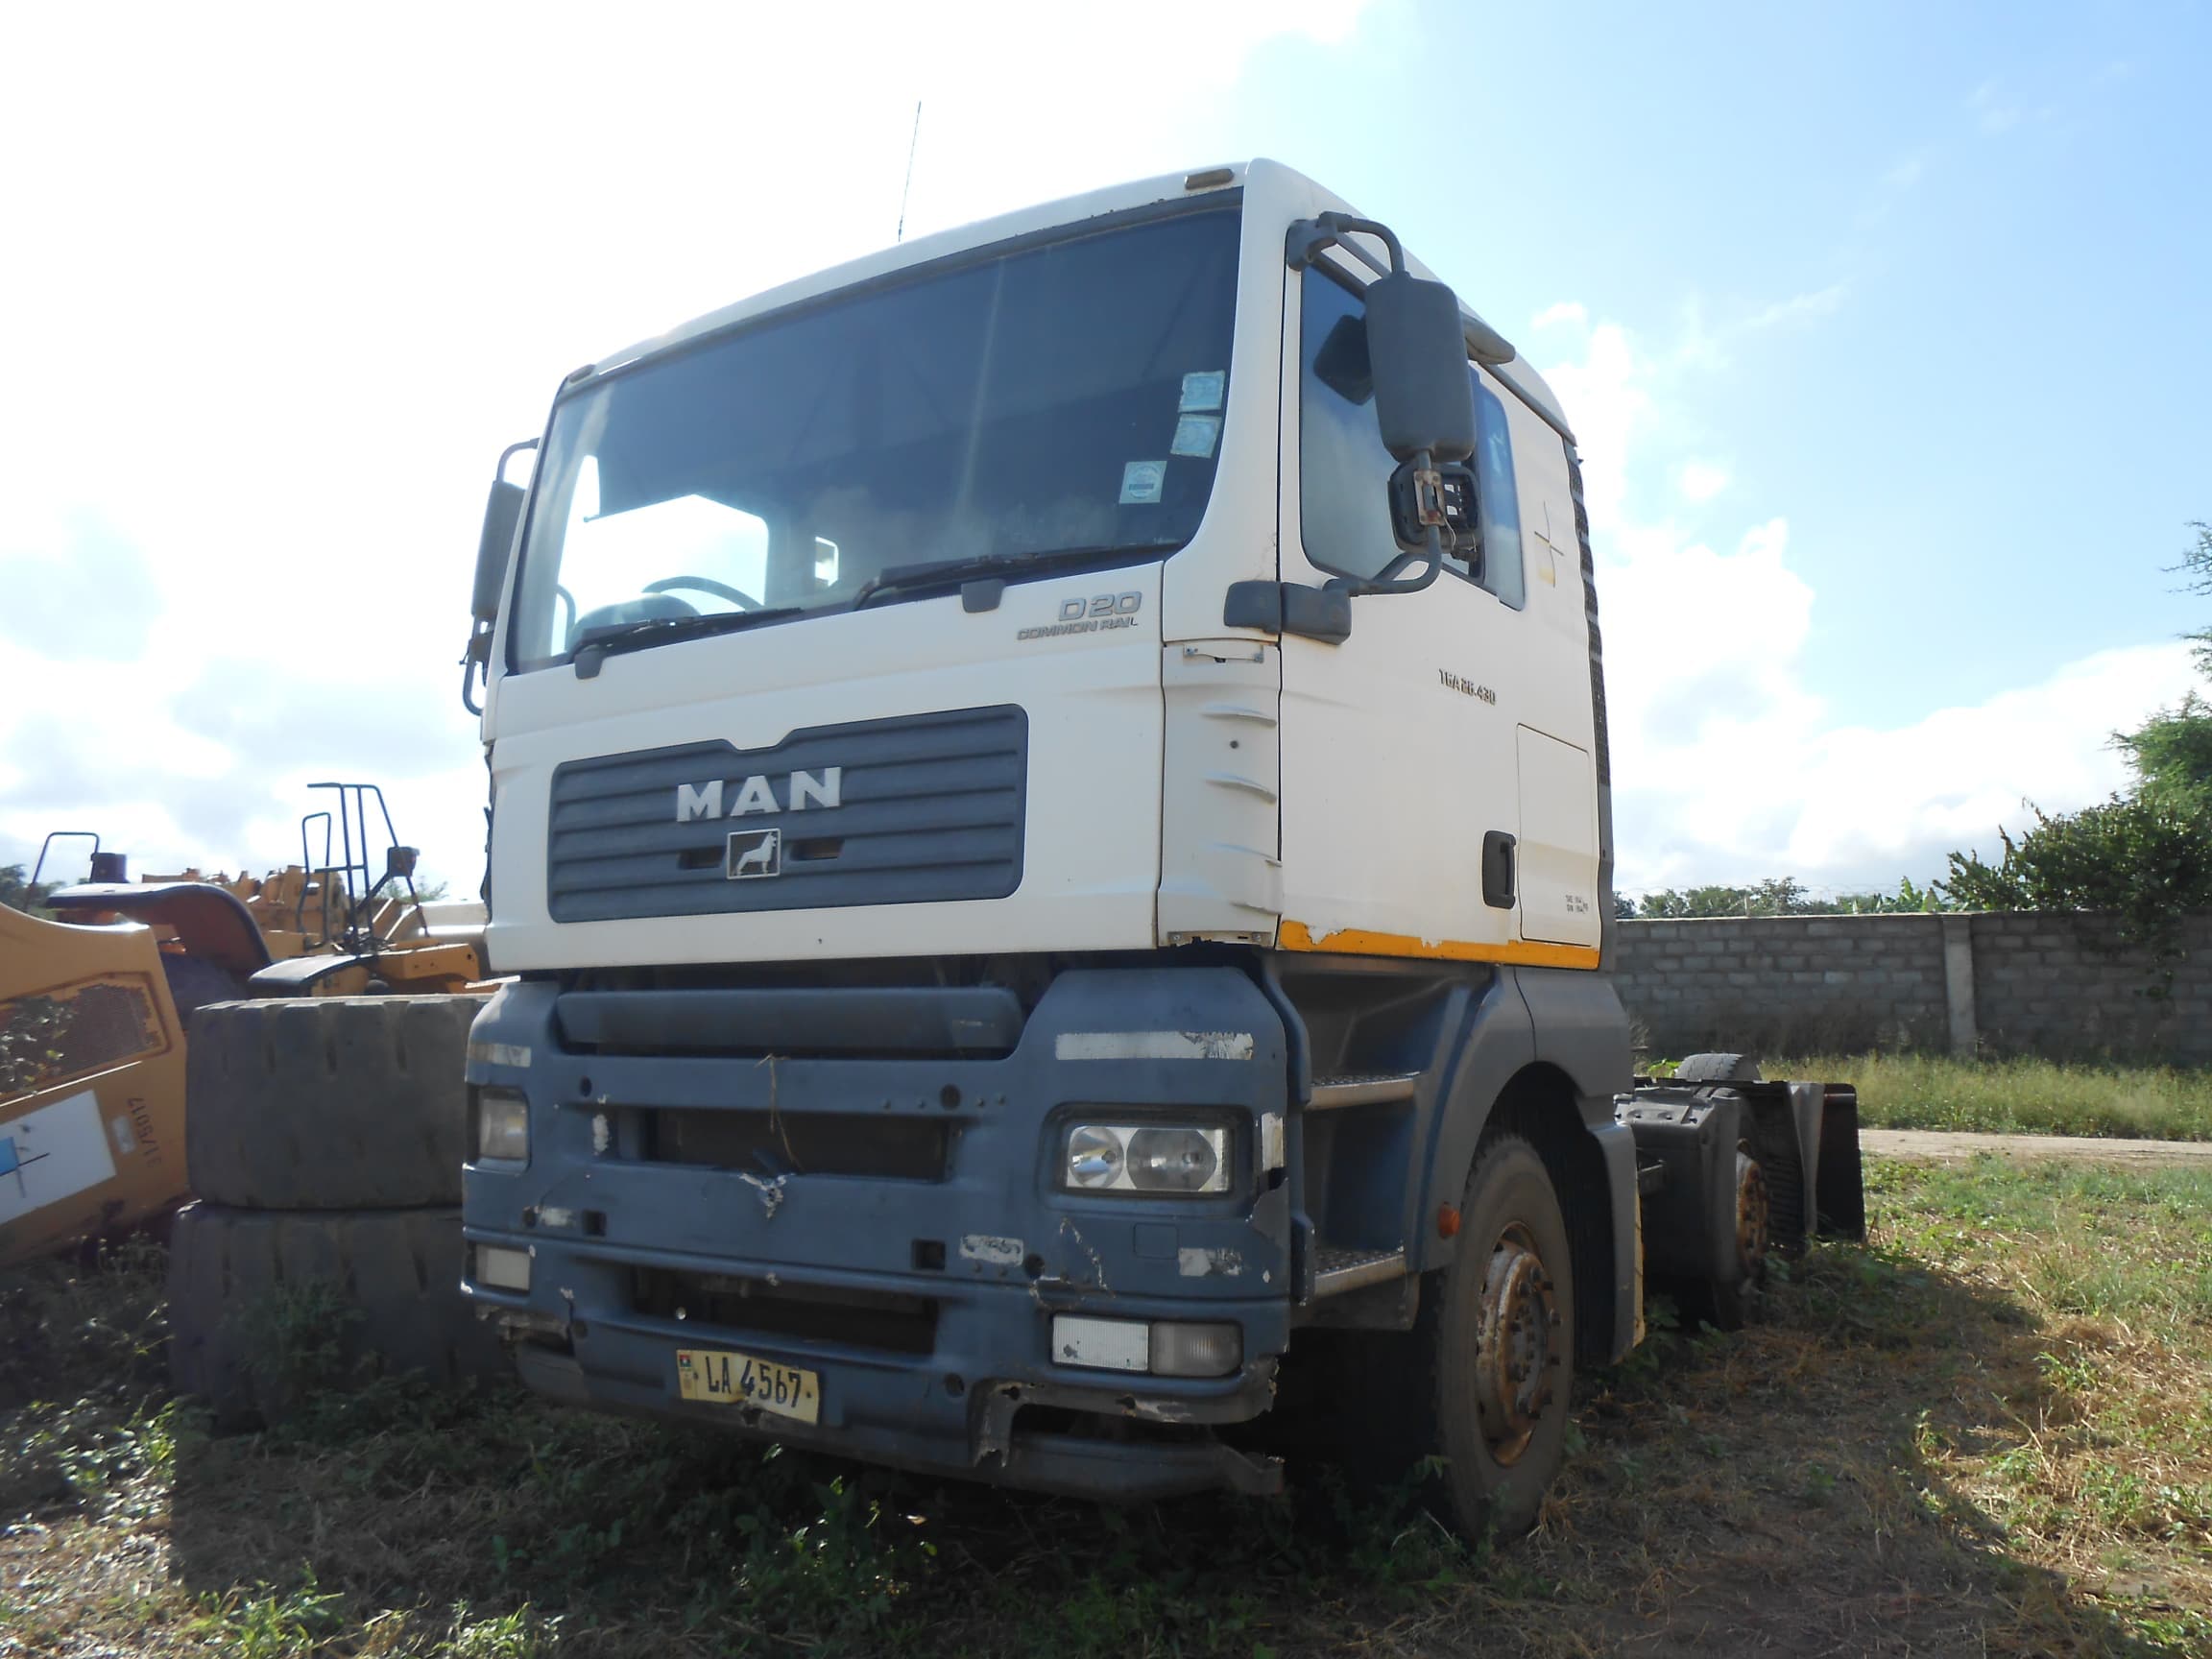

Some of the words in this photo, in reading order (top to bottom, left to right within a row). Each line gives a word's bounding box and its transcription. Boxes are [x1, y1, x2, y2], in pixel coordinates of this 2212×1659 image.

[1059, 590, 1142, 621] D20
[1017, 620, 1098, 640] COMMON
[1099, 616, 1139, 630] RAIL
[677, 766, 842, 823] MAN
[706, 1356, 732, 1394] LA
[740, 1359, 802, 1408] 4567
